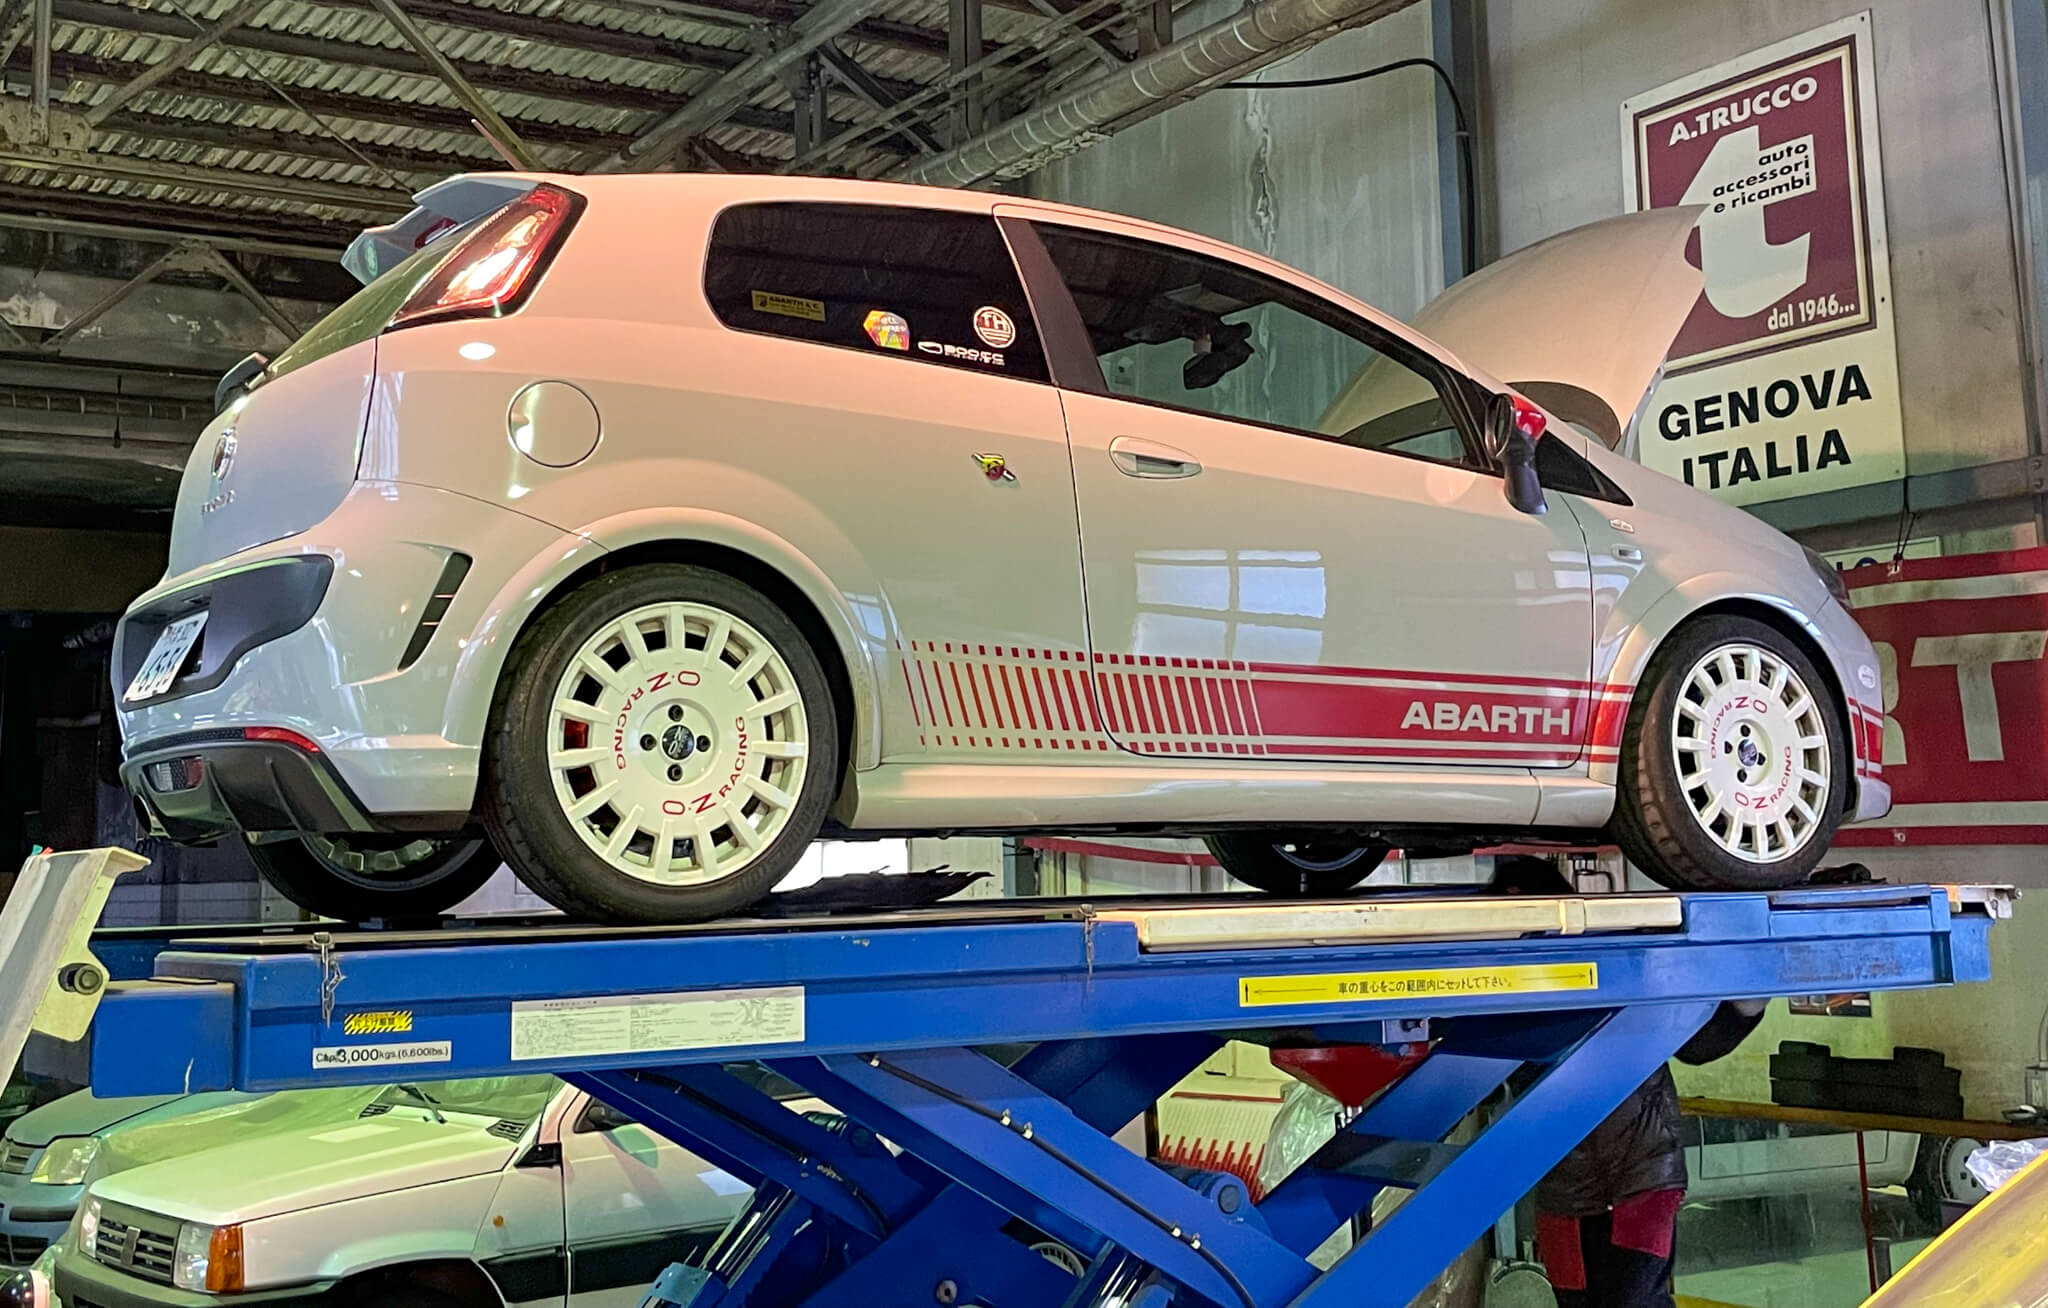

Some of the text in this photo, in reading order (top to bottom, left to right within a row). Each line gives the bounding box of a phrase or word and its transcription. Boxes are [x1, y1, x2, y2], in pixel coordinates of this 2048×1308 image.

[1668, 77, 1818, 147] A.TRUCCO
[1712, 155, 1810, 198] accessori
[1758, 142, 1808, 166] auto
[1713, 172, 1812, 214] e ricambi
[1767, 294, 1856, 331] dal 1946...
[1658, 364, 1873, 442] GENOVA
[1682, 428, 1852, 489] ITALIA
[613, 687, 645, 770] RACING
[1400, 701, 1570, 736] ABARTH
[717, 715, 749, 798] RACING
